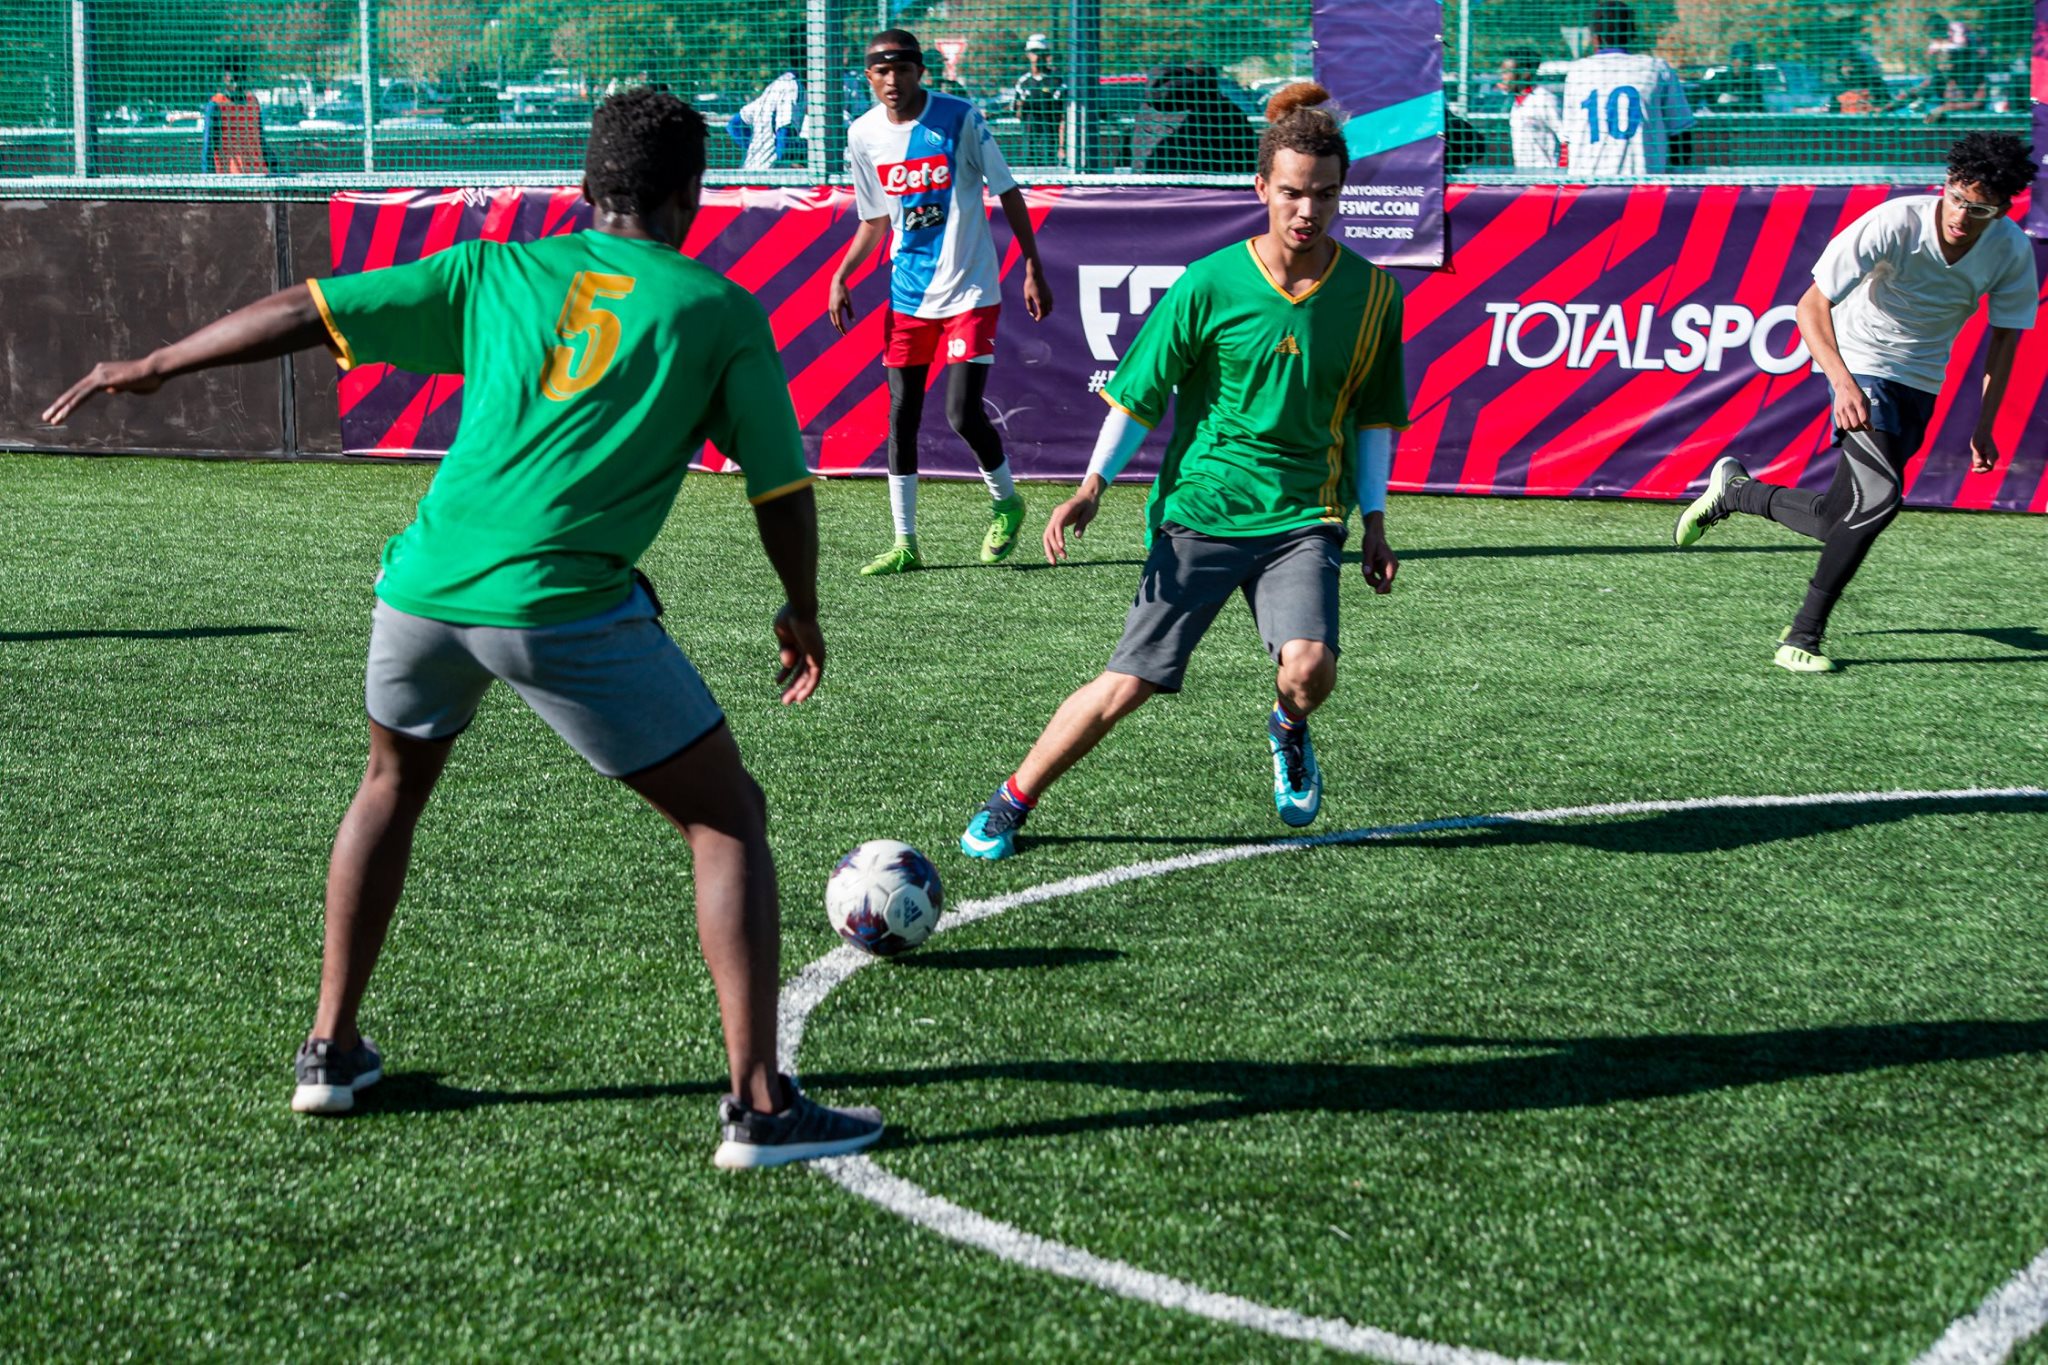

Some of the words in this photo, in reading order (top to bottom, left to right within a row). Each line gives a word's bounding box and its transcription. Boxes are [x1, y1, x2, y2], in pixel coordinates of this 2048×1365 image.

[1581, 85, 1642, 145] 10
[884, 162, 949, 192] Lete
[1344, 226, 1415, 240] TOTALSPORTS
[540, 270, 636, 401] 5
[1485, 302, 1824, 374] TOTALSPO
